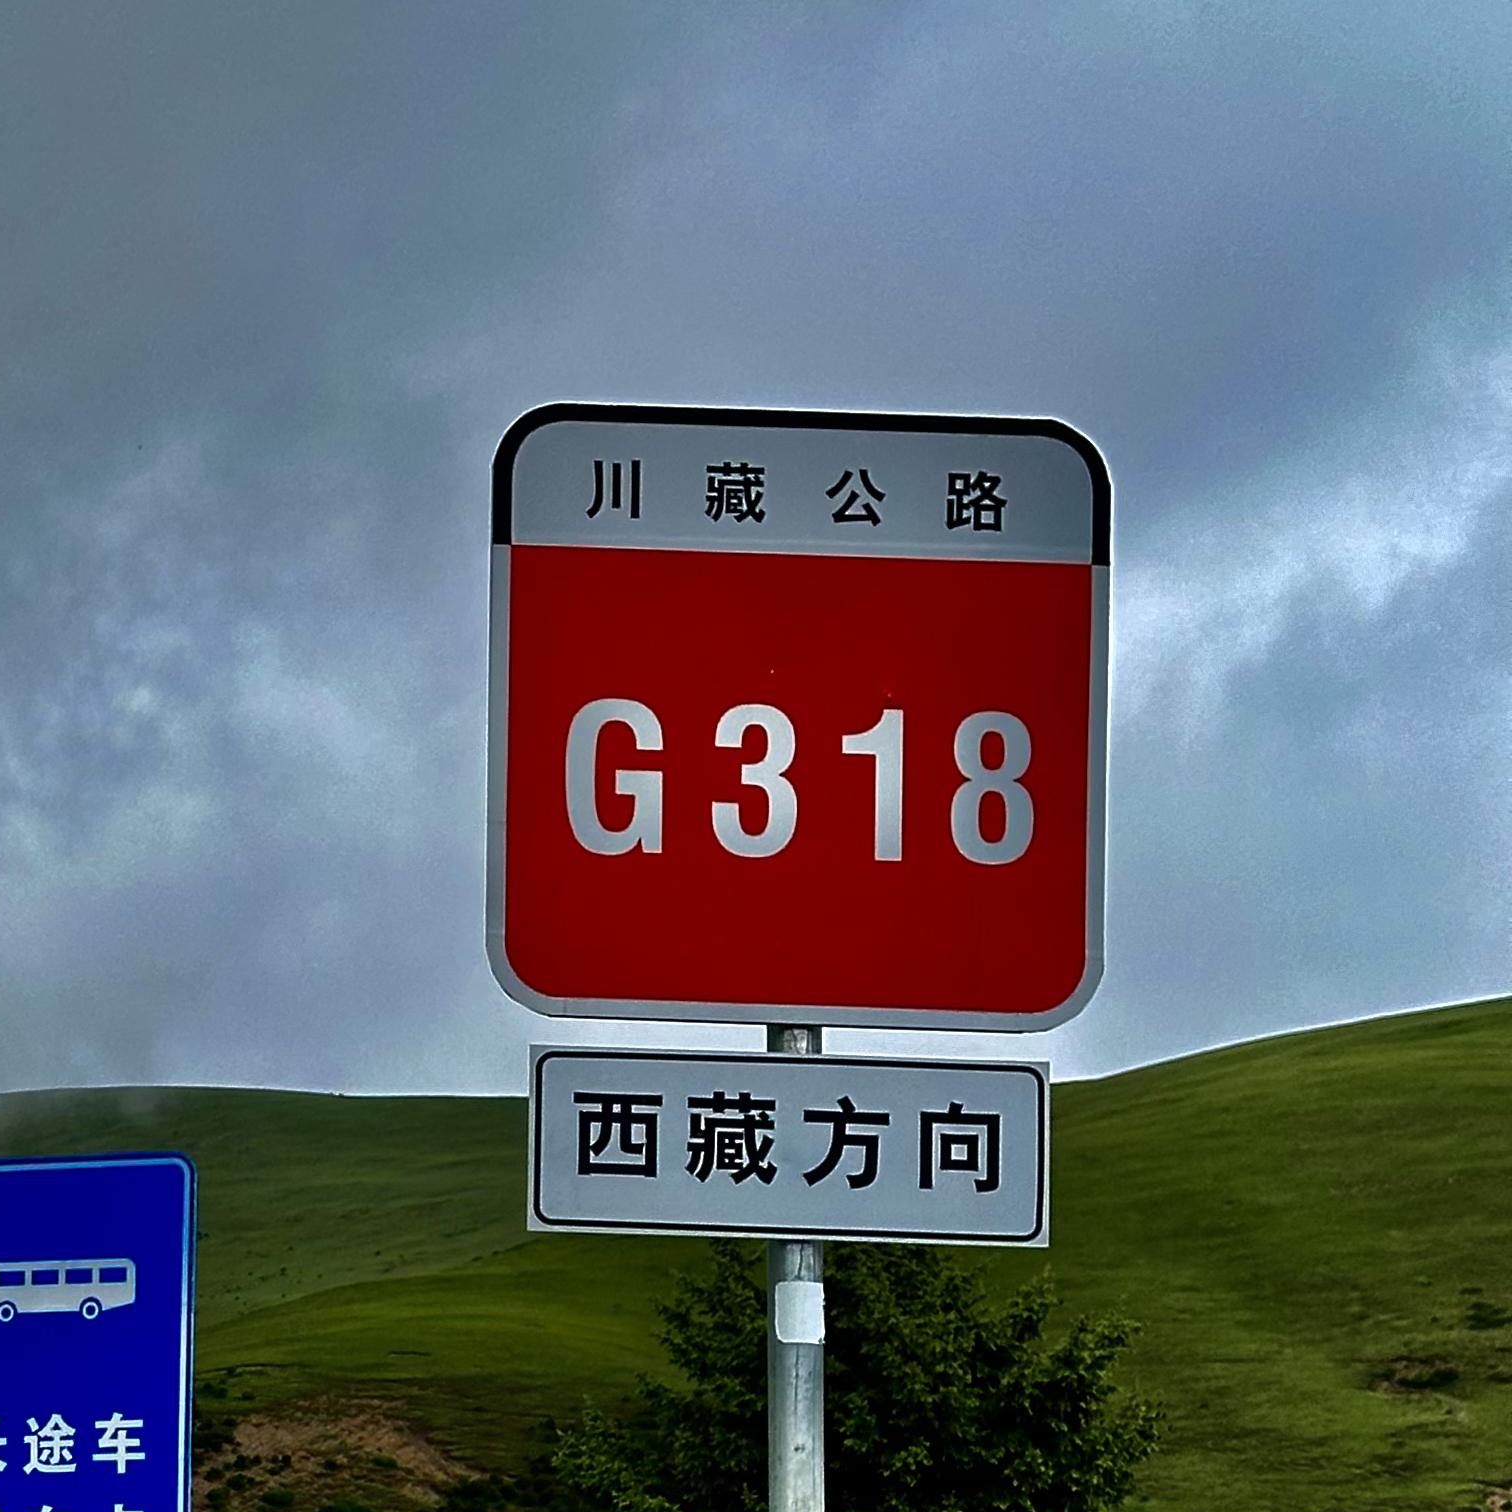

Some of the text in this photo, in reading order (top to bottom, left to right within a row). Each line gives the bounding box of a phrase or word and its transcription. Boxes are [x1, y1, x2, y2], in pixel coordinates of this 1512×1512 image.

[585, 458, 1009, 533] 川藏公路
[564, 697, 1036, 866] G318
[572, 1090, 1002, 1194] 西藏方向
